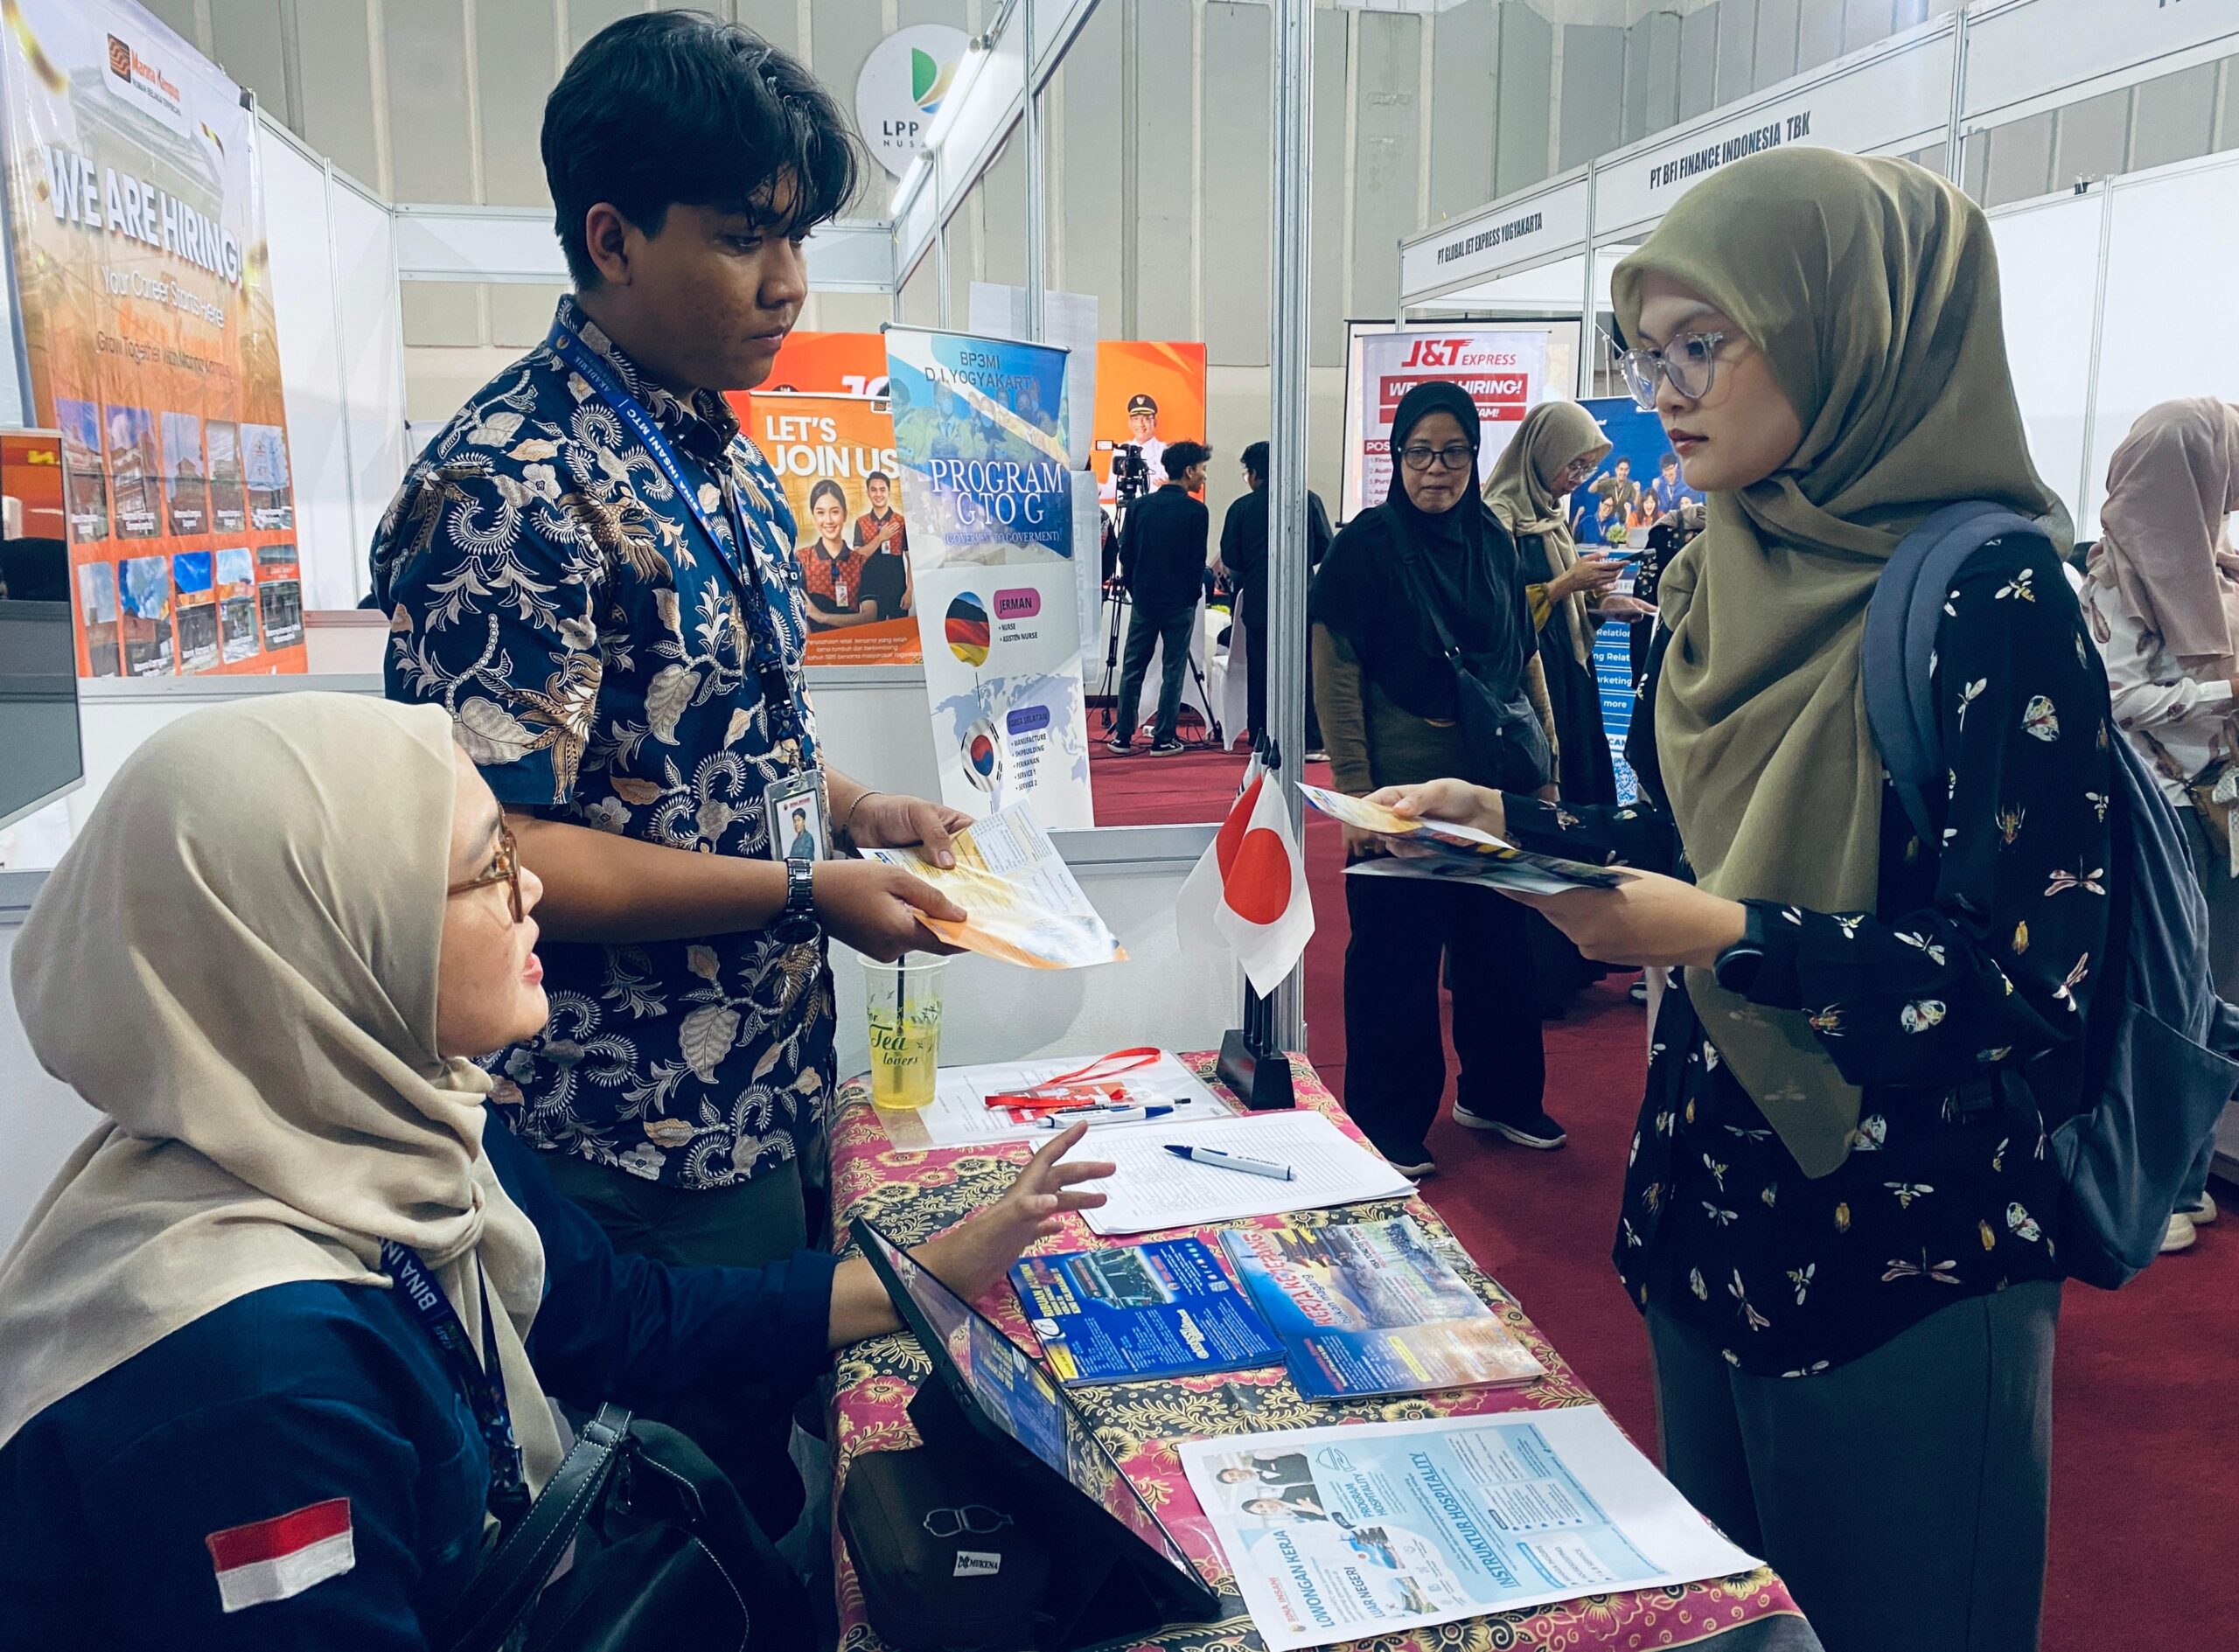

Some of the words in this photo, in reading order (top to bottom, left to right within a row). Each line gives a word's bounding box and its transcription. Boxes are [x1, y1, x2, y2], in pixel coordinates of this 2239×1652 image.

[883, 121, 919, 136] LPP
[1650, 166, 1662, 189] PT
[1664, 160, 1678, 185] BFI
[1679, 144, 1720, 179] FINANCE
[1722, 122, 1781, 164] INDONESIA
[1786, 110, 1811, 142] TBK
[44, 143, 101, 227] WE
[106, 167, 160, 247] ARE
[160, 192, 243, 289] HIRING!
[1437, 247, 1445, 265] PT
[1445, 240, 1465, 262] GLOBAL
[1465, 237, 1475, 255] JET
[1475, 227, 1501, 253] EXPRESS
[1501, 212, 1543, 242] YOGYAKARTA
[101, 265, 129, 296] Your
[132, 270, 169, 303] Career
[960, 352, 1001, 369] BP3MI
[1401, 338, 1475, 367] J&T
[1461, 354, 1517, 366] EXPRESS
[1461, 380, 1522, 394] HIRING!
[626, 408, 651, 436] MTC
[766, 415, 836, 443] LET'S
[647, 435, 679, 480] INSANI
[771, 444, 850, 477] JOIN
[854, 447, 900, 478] US
[929, 459, 1064, 492] PROGRAM
[677, 480, 699, 512] BINA
[957, 492, 975, 525] G
[979, 492, 1016, 525] TO
[1024, 492, 1044, 524] G
[1000, 597, 1032, 614] JERMAN
[1003, 633, 1020, 642] ASISTEN
[1592, 652, 1604, 662] ng
[1023, 713, 1048, 725] SELATAN
[1015, 733, 1046, 746] MANUFACTURE
[1015, 745, 1044, 756] SHIPBUILDING
[1016, 756, 1040, 769] PERIKANAN
[1017, 770, 1033, 779] SERVICE
[1019, 781, 1033, 791] SERVICE
[869, 1024, 909, 1051] Tea
[883, 1052, 918, 1066] lovers
[401, 1259, 437, 1311] BINA
[1301, 1273, 1332, 1300] magang
[1030, 1289, 1057, 1317] RIBUAN
[1287, 1290, 1337, 1326] KERJA
[1324, 1302, 1352, 1323] bukan
[1344, 1482, 1375, 1517] PROGRAM
[1351, 1473, 1388, 1516] HOSPITALITY
[1407, 1452, 1465, 1519] HOSPITALITY
[1272, 1530, 1301, 1563] KERJA
[1454, 1522, 1517, 1588] INSTRUKTUR
[1287, 1563, 1336, 1628] LOWONGAN
[1343, 1565, 1371, 1598] NEGERI
[1362, 1599, 1385, 1618] LUAR
